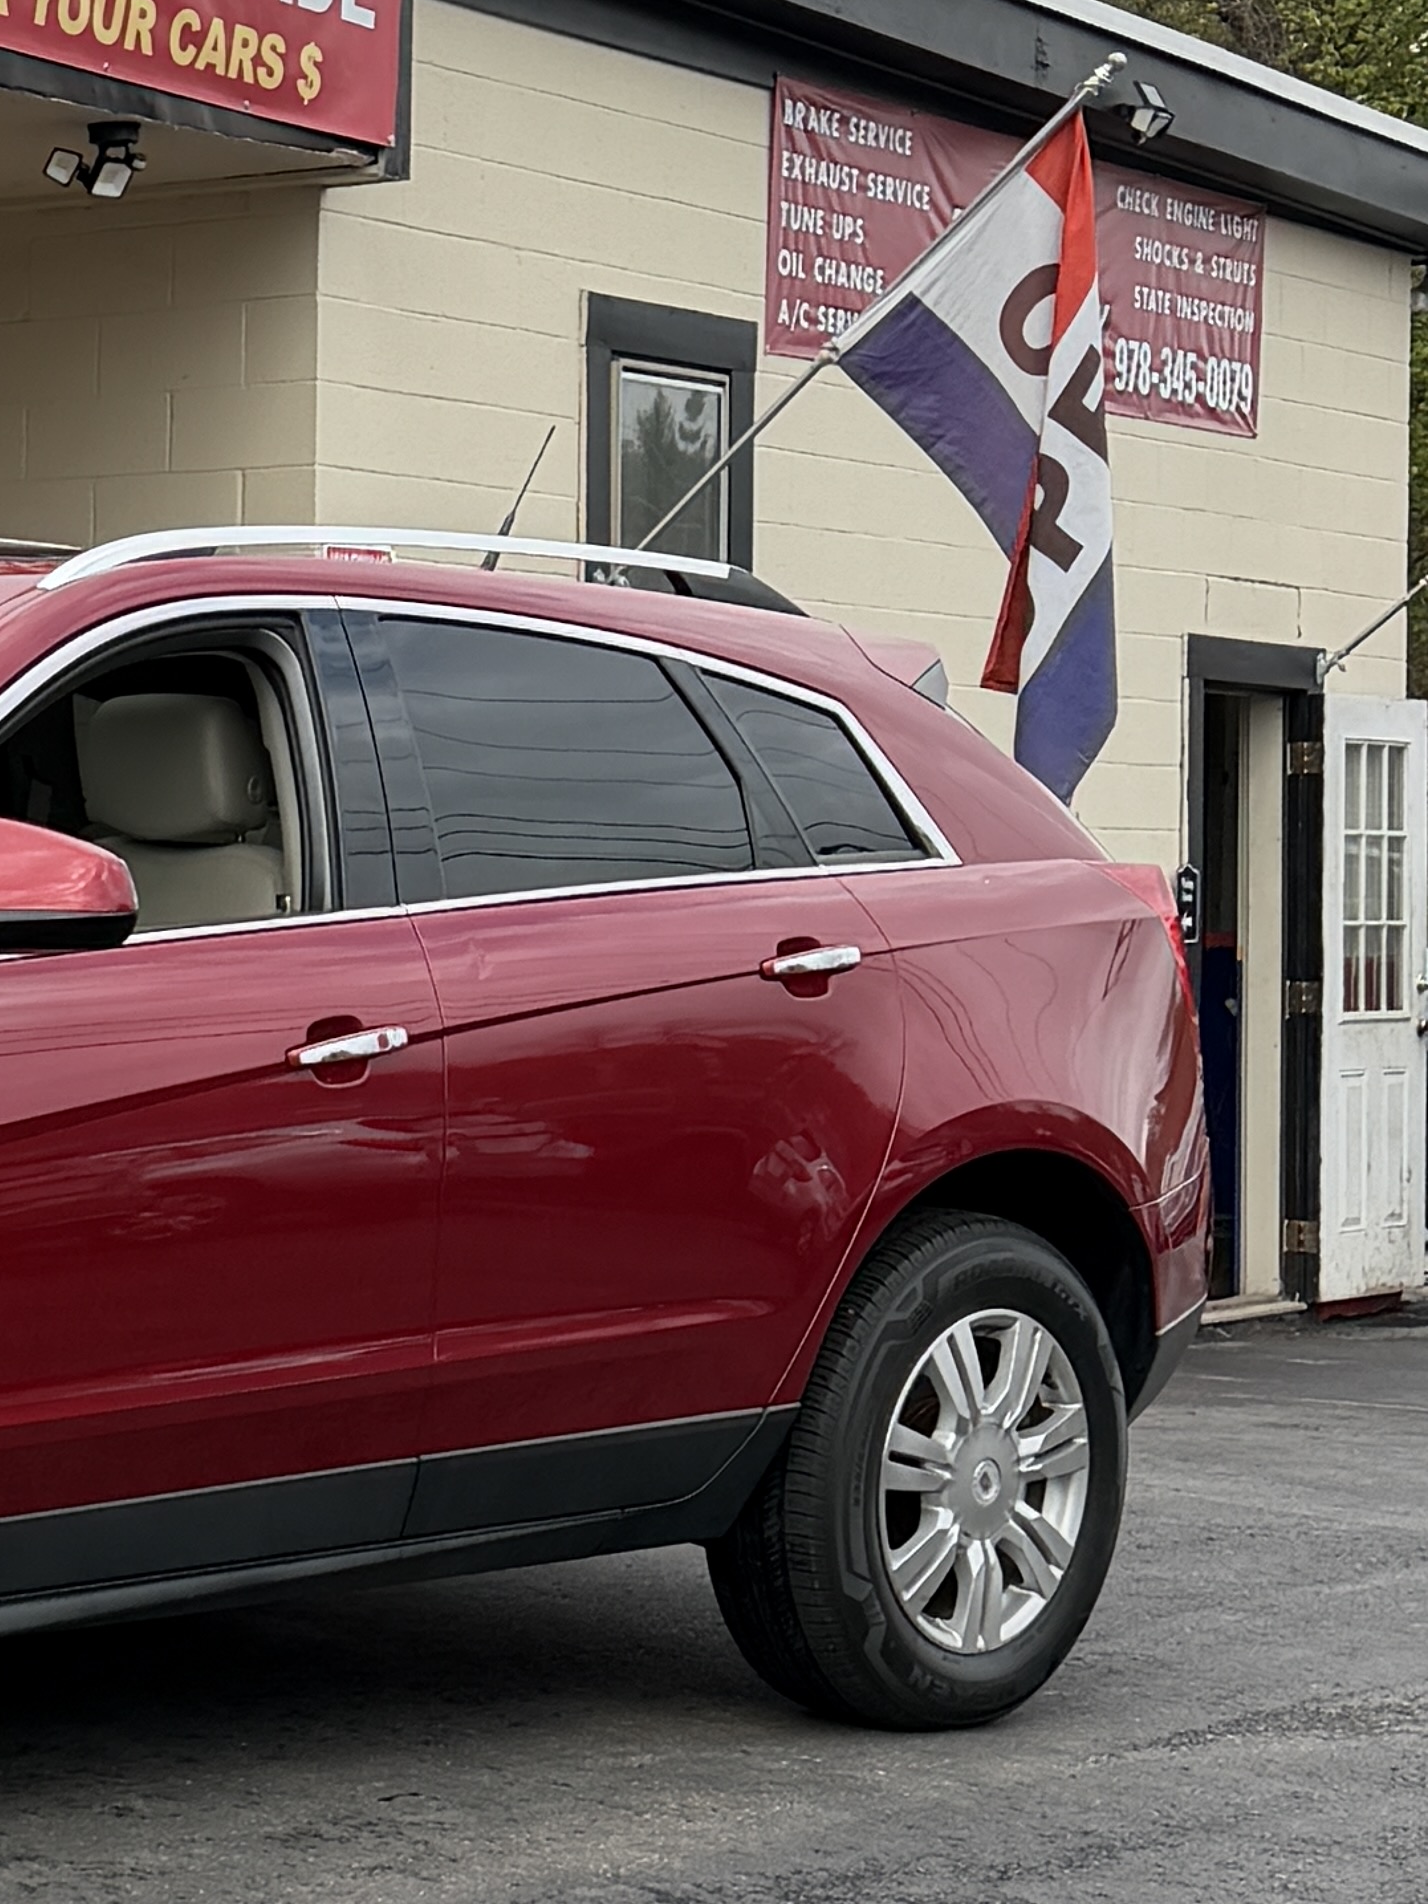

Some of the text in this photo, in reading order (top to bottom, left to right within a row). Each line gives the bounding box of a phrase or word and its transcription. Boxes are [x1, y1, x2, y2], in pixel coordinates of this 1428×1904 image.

[169, 9, 285, 89] CARS
[296, 42, 322, 104] $
[783, 99, 913, 156] BRAKE SERVICE
[781, 151, 930, 210] EXHAUST SERVICE
[780, 201, 864, 244] TUNE UPS
[1117, 185, 1259, 242] CHECK ENGINE LIGHT
[777, 249, 884, 294] OIL CHANGE
[1134, 237, 1256, 286] SHOCKS & STRUTS
[778, 299, 858, 334] A/C SERV
[1134, 286, 1171, 315] STATE
[1176, 296, 1254, 332] INSPECTION
[1115, 337, 1253, 413] 978-345-0079
